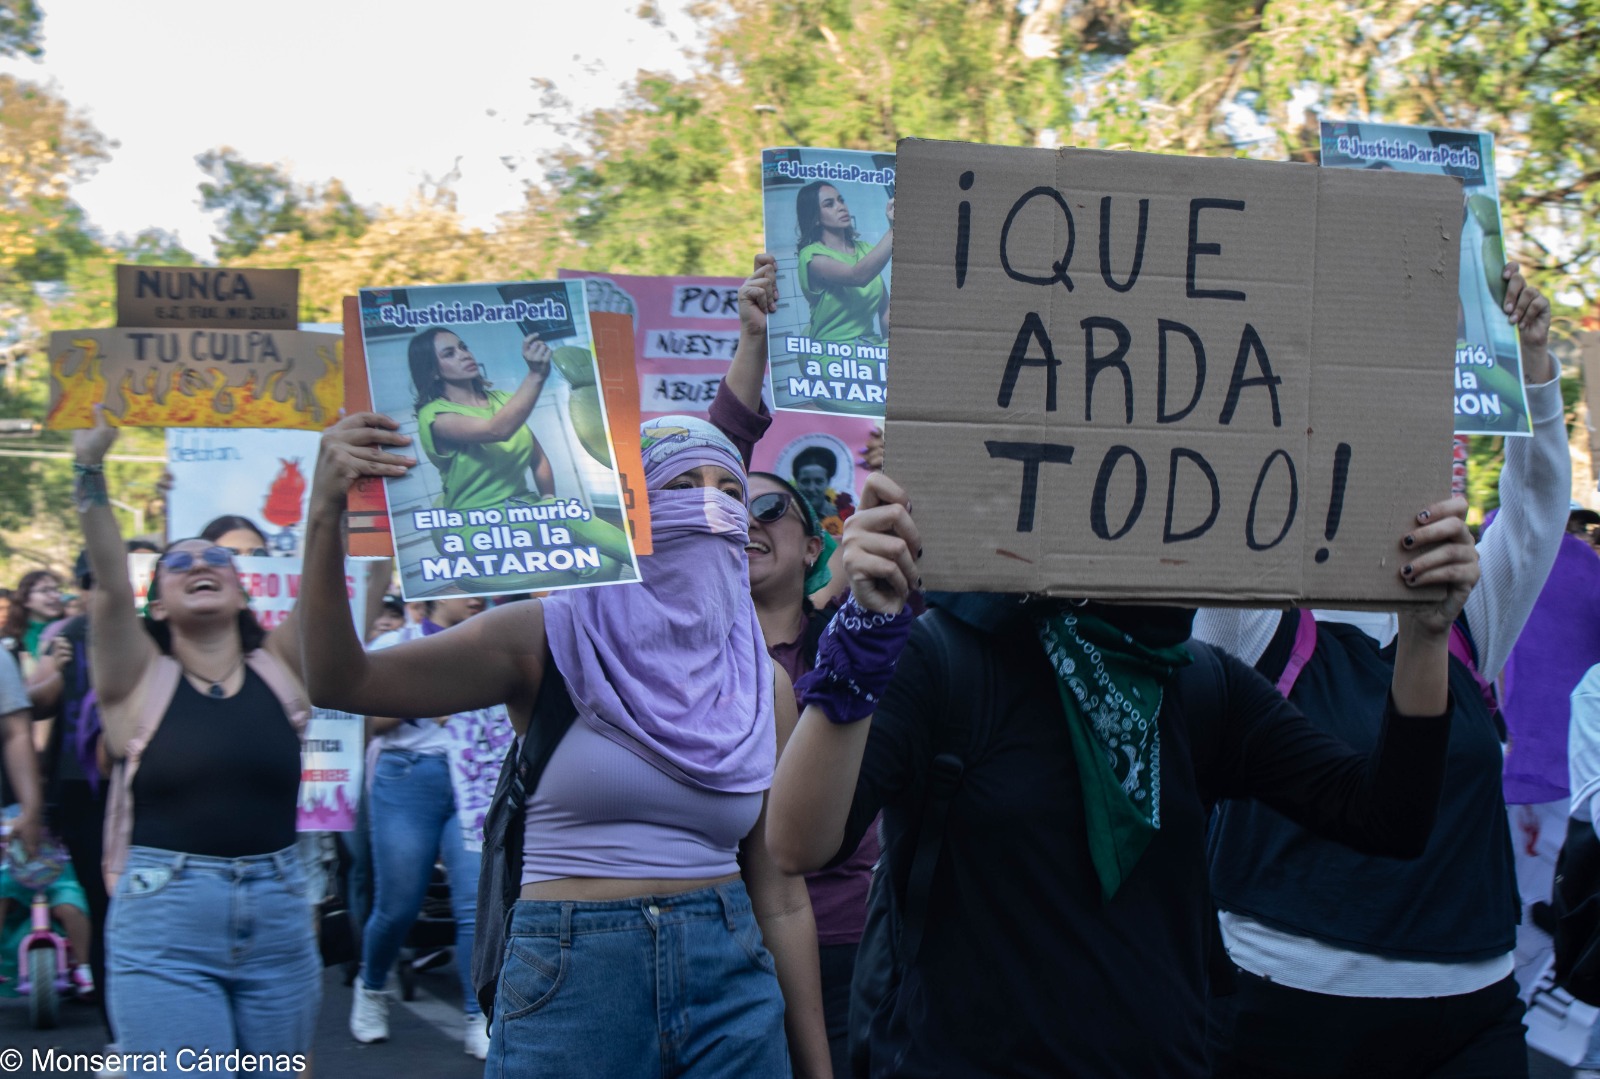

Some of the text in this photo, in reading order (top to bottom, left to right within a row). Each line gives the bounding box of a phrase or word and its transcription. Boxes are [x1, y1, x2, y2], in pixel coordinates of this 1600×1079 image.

[1338, 136, 1479, 169] #JusticiaParaPerla
[778, 161, 896, 185] #JusticiaParaP
[955, 170, 1246, 301] ¡QUE
[135, 270, 255, 301] NUNCA
[382, 299, 566, 327] #JusticiaParaPerla
[126, 331, 283, 364] TU CULPA
[786, 337, 888, 360] Ella no mu
[1455, 345, 1493, 367] rió,
[806, 359, 887, 381] a ella l
[996, 312, 1282, 427] ARDA
[653, 378, 720, 402] ABUE
[789, 378, 887, 403] MATAR
[414, 499, 590, 529] Ella no murió,
[983, 439, 1352, 562] TODO!
[444, 523, 571, 553] a ella la
[422, 547, 600, 580] MATARON
